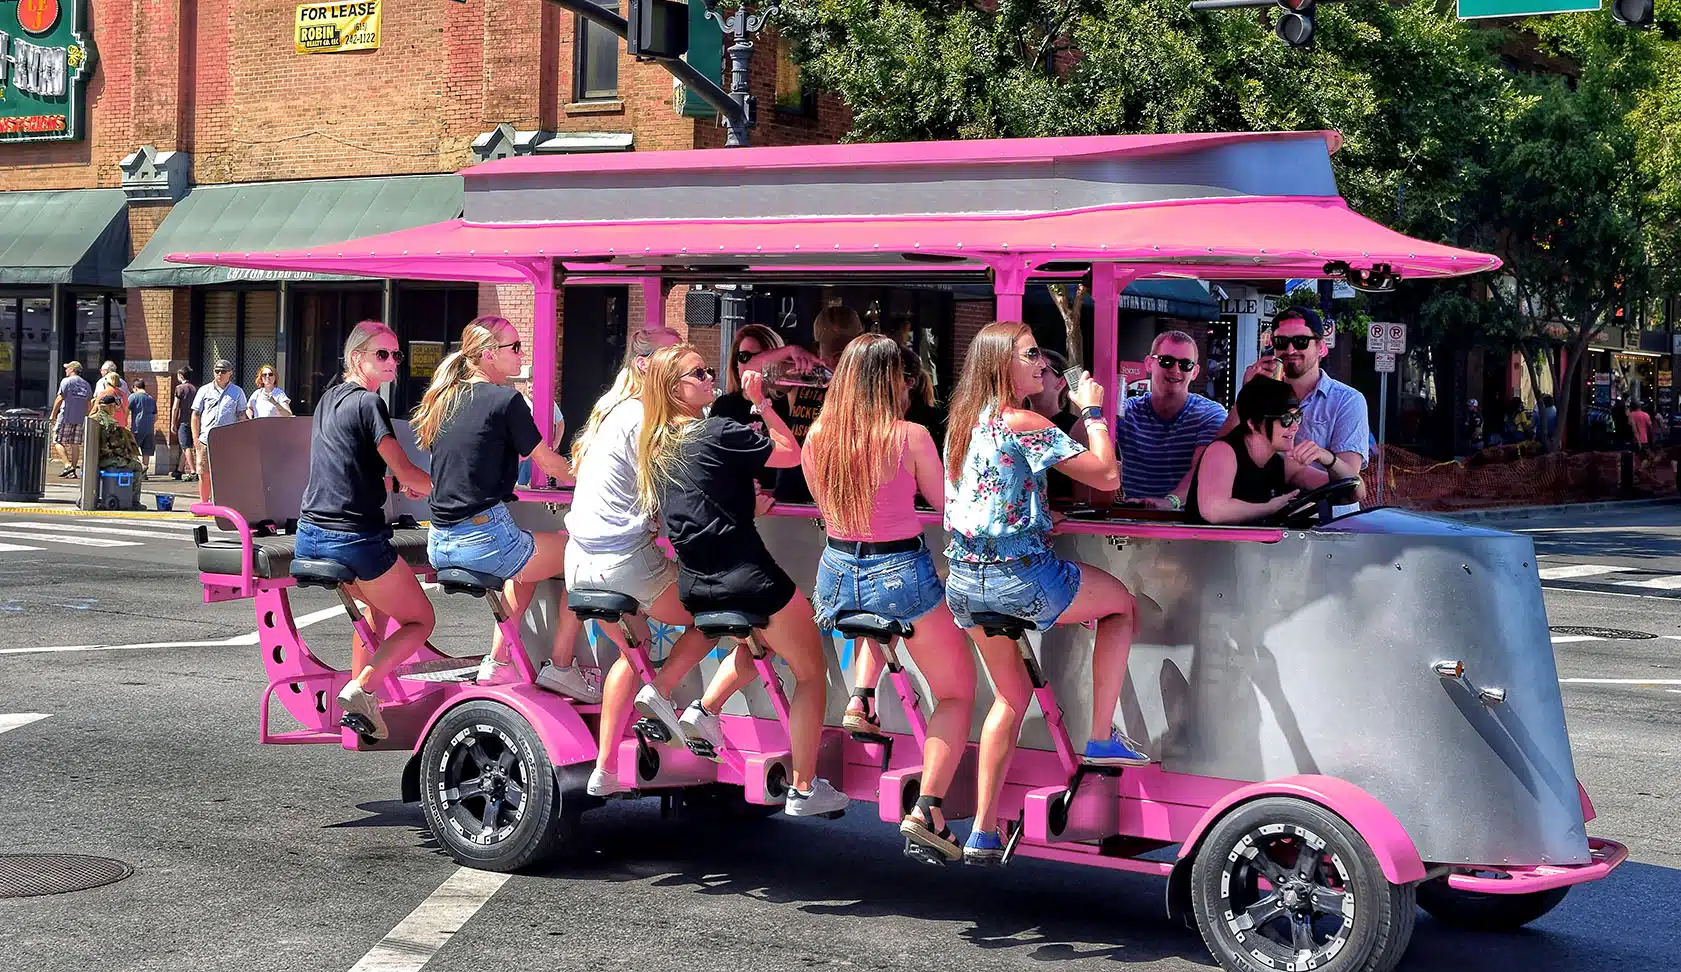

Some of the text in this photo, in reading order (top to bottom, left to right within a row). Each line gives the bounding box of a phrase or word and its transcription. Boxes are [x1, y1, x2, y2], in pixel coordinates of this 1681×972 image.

[300, 2, 376, 21] FOR LEASE
[301, 26, 335, 42] ROBIN
[345, 32, 376, 45] 242-1122
[1119, 294, 1139, 309] OTTON
